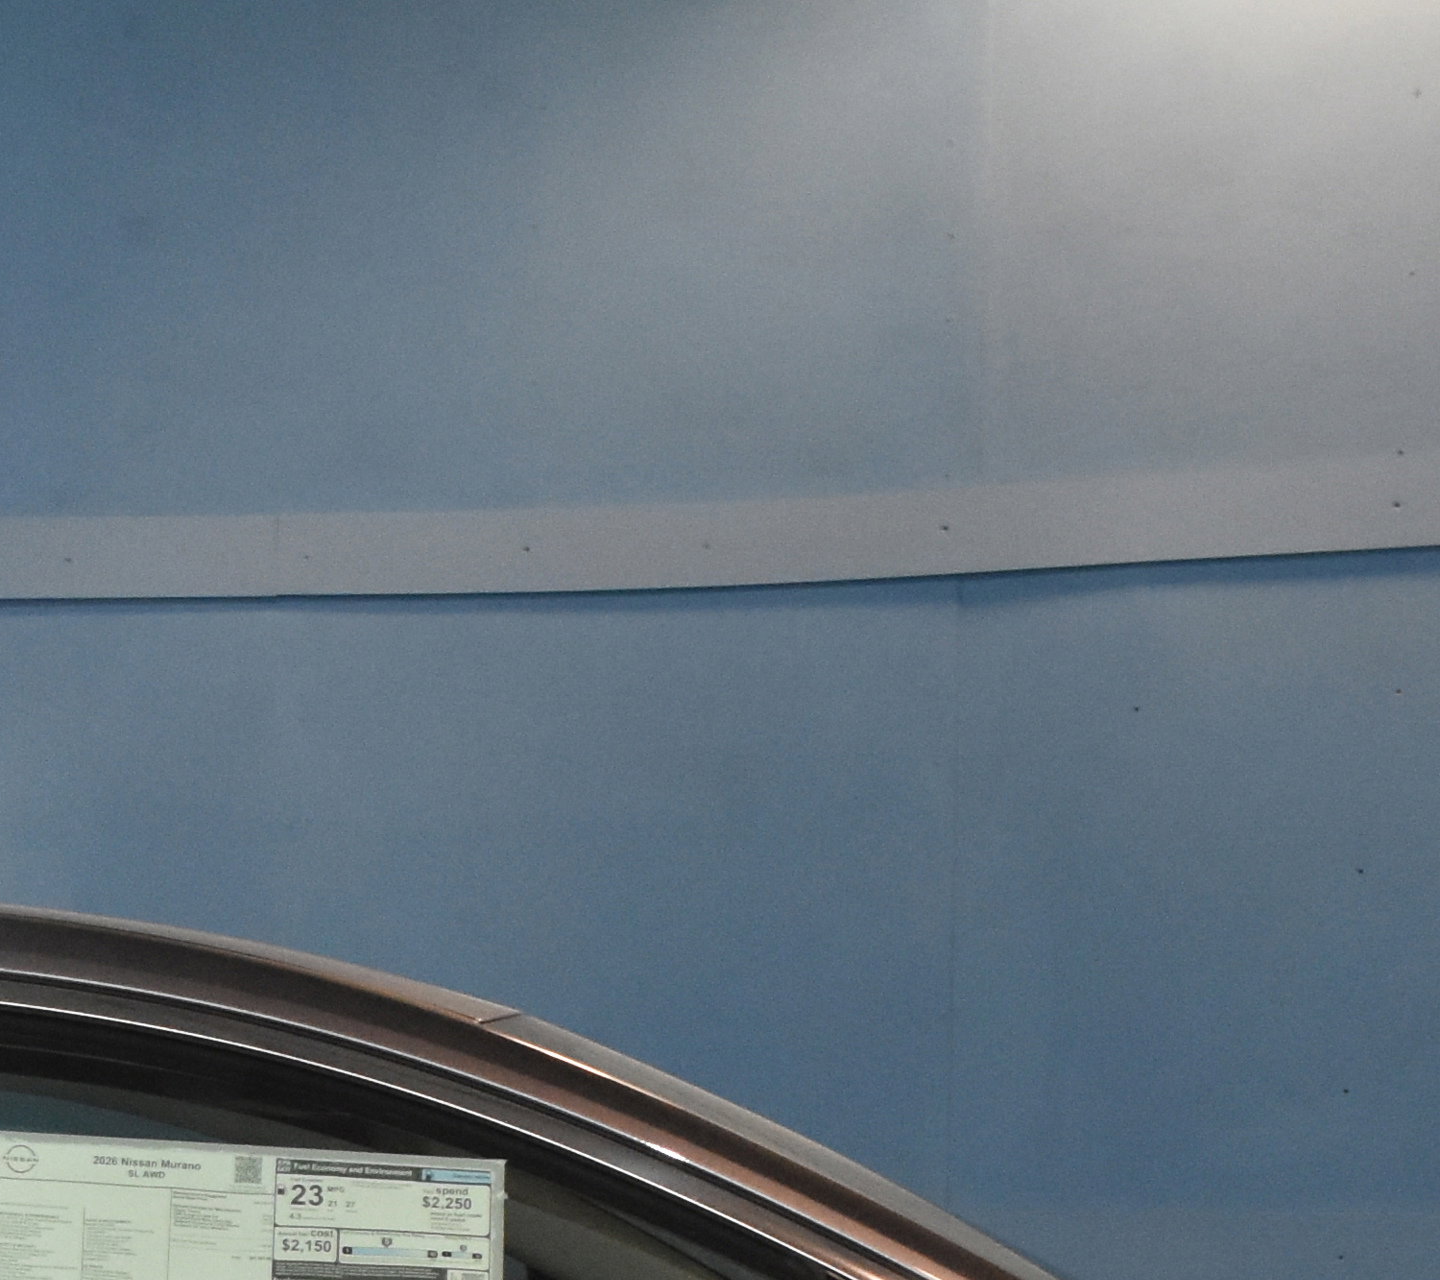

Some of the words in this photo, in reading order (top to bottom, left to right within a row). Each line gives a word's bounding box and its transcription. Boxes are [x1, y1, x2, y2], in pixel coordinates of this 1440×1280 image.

[93, 1155, 118, 1166] 2026
[121, 1157, 158, 1168] Nissan
[161, 1159, 202, 1171] Murano
[293, 1162, 311, 1171] Fuel
[311, 1164, 348, 1174] Economy
[348, 1166, 364, 1174] and
[128, 1169, 140, 1178] SL
[142, 1170, 166, 1179] AWD
[290, 1184, 324, 1206] 23
[436, 1187, 469, 1196] spend
[282, 1238, 332, 1253] $2,150
